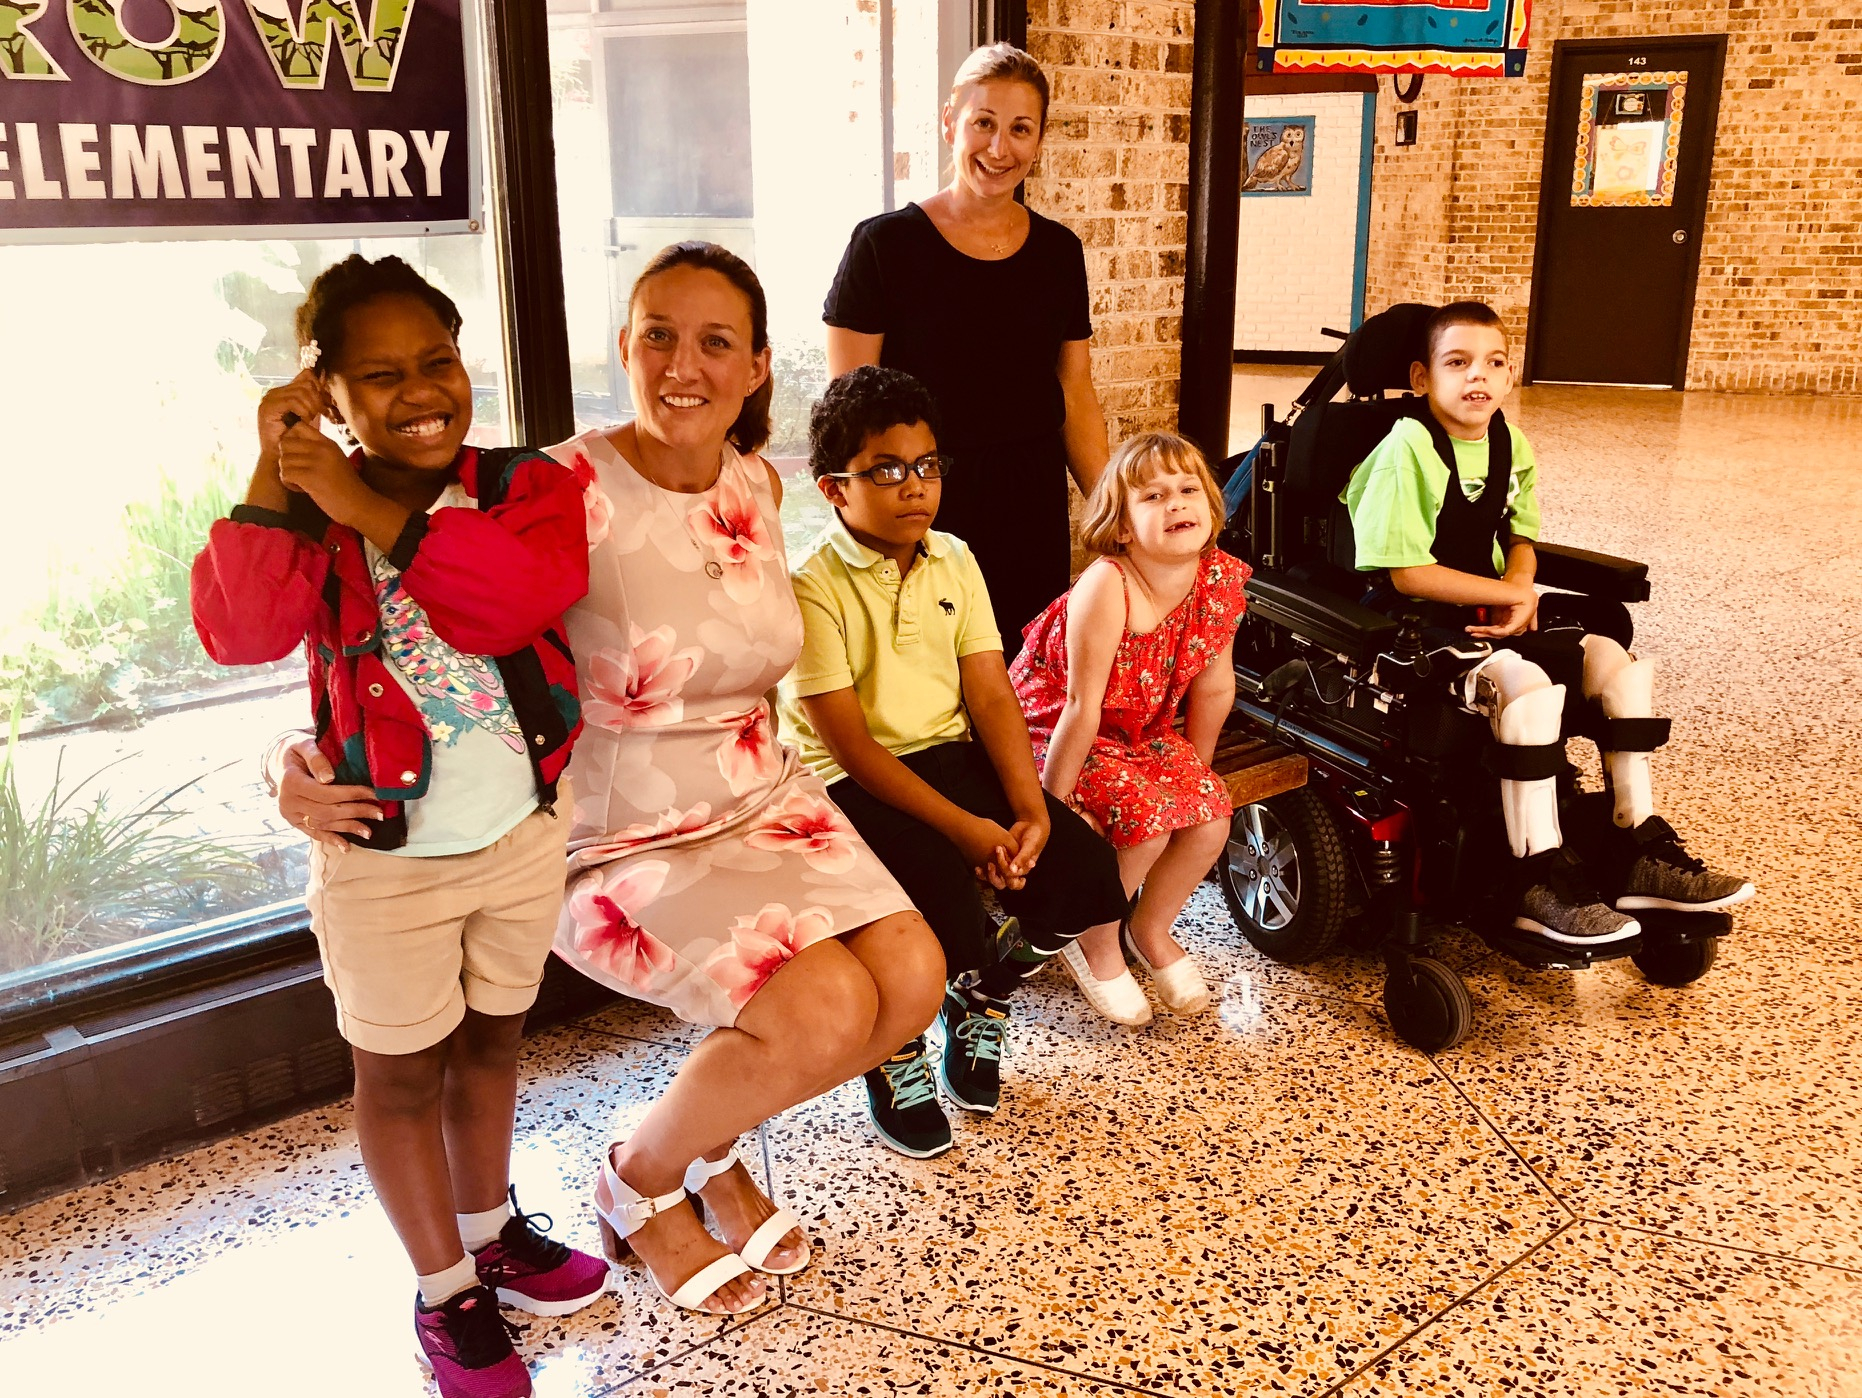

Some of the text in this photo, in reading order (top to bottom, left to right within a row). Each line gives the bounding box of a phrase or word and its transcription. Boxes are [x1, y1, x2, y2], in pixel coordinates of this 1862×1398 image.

[1628, 56, 1647, 65] 143
[1253, 125, 1271, 133] THE
[1250, 139, 1274, 147] NEST
